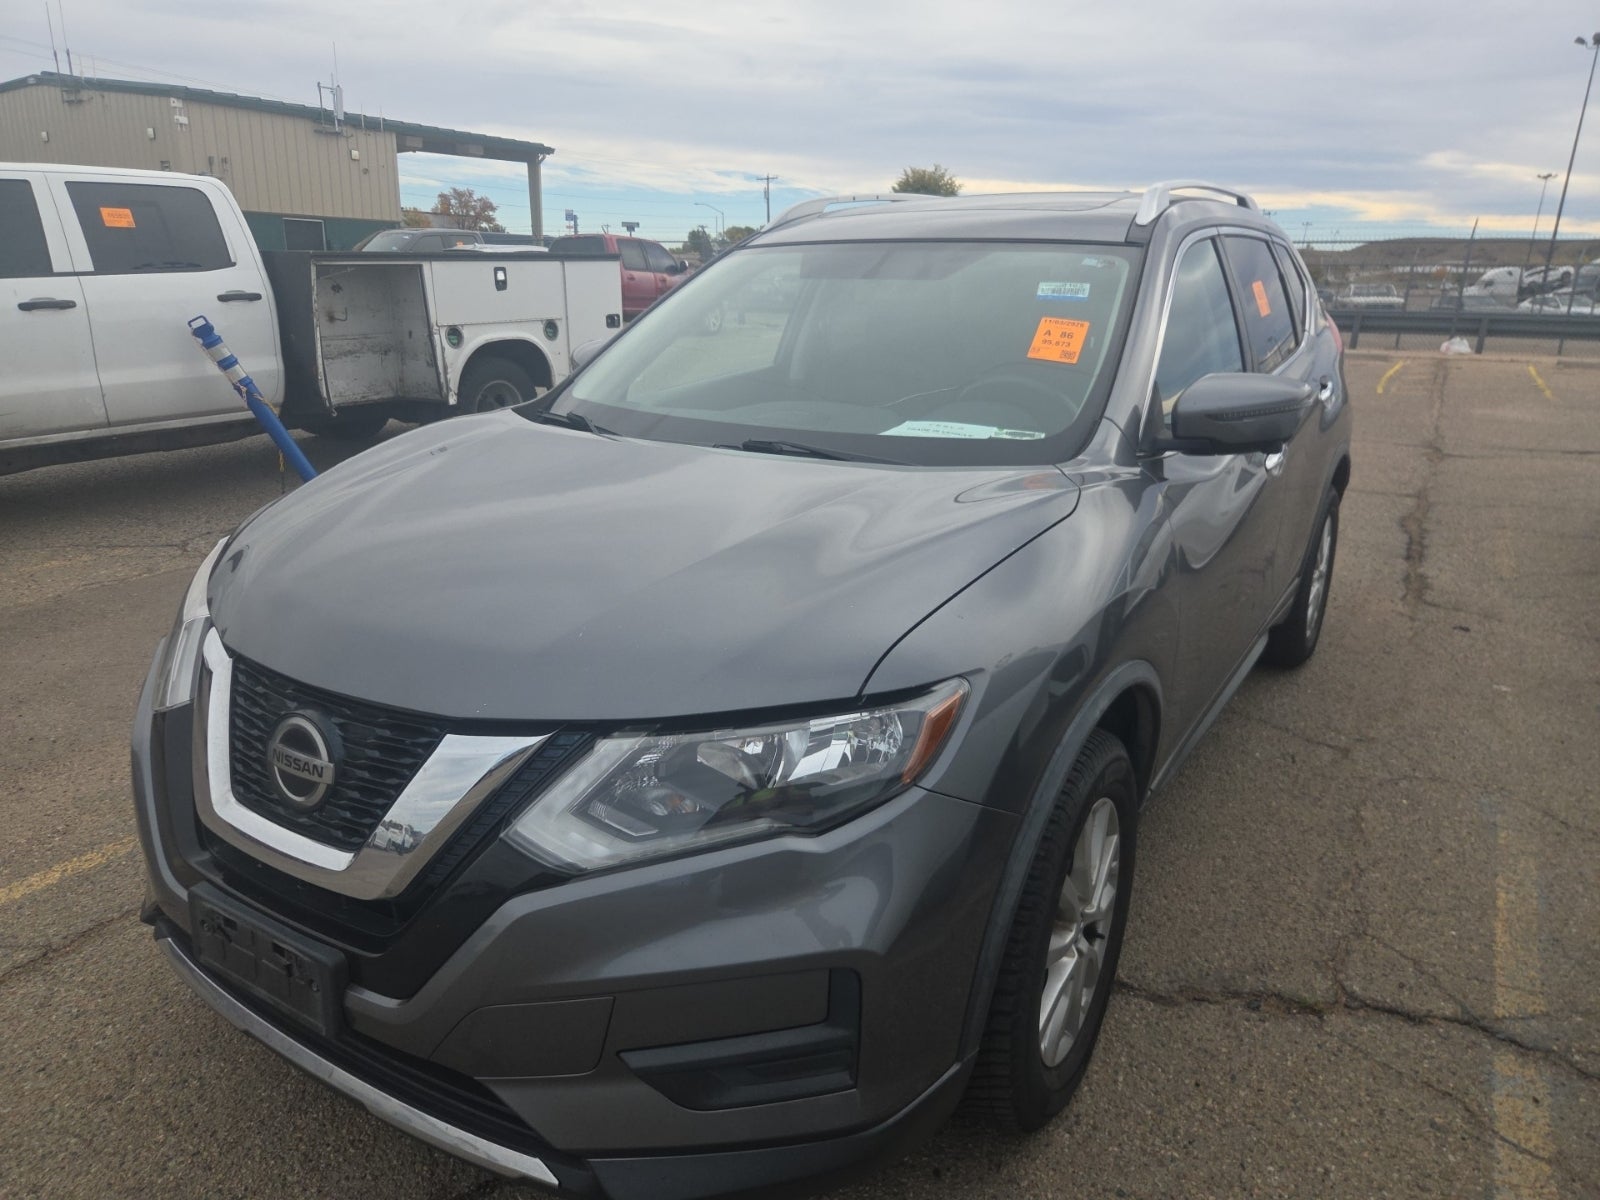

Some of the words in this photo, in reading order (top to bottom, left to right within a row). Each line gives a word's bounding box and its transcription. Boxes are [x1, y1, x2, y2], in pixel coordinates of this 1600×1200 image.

[1043, 329, 1051, 337] A
[1059, 331, 1074, 339] 86
[272, 748, 324, 778] NISSAN
